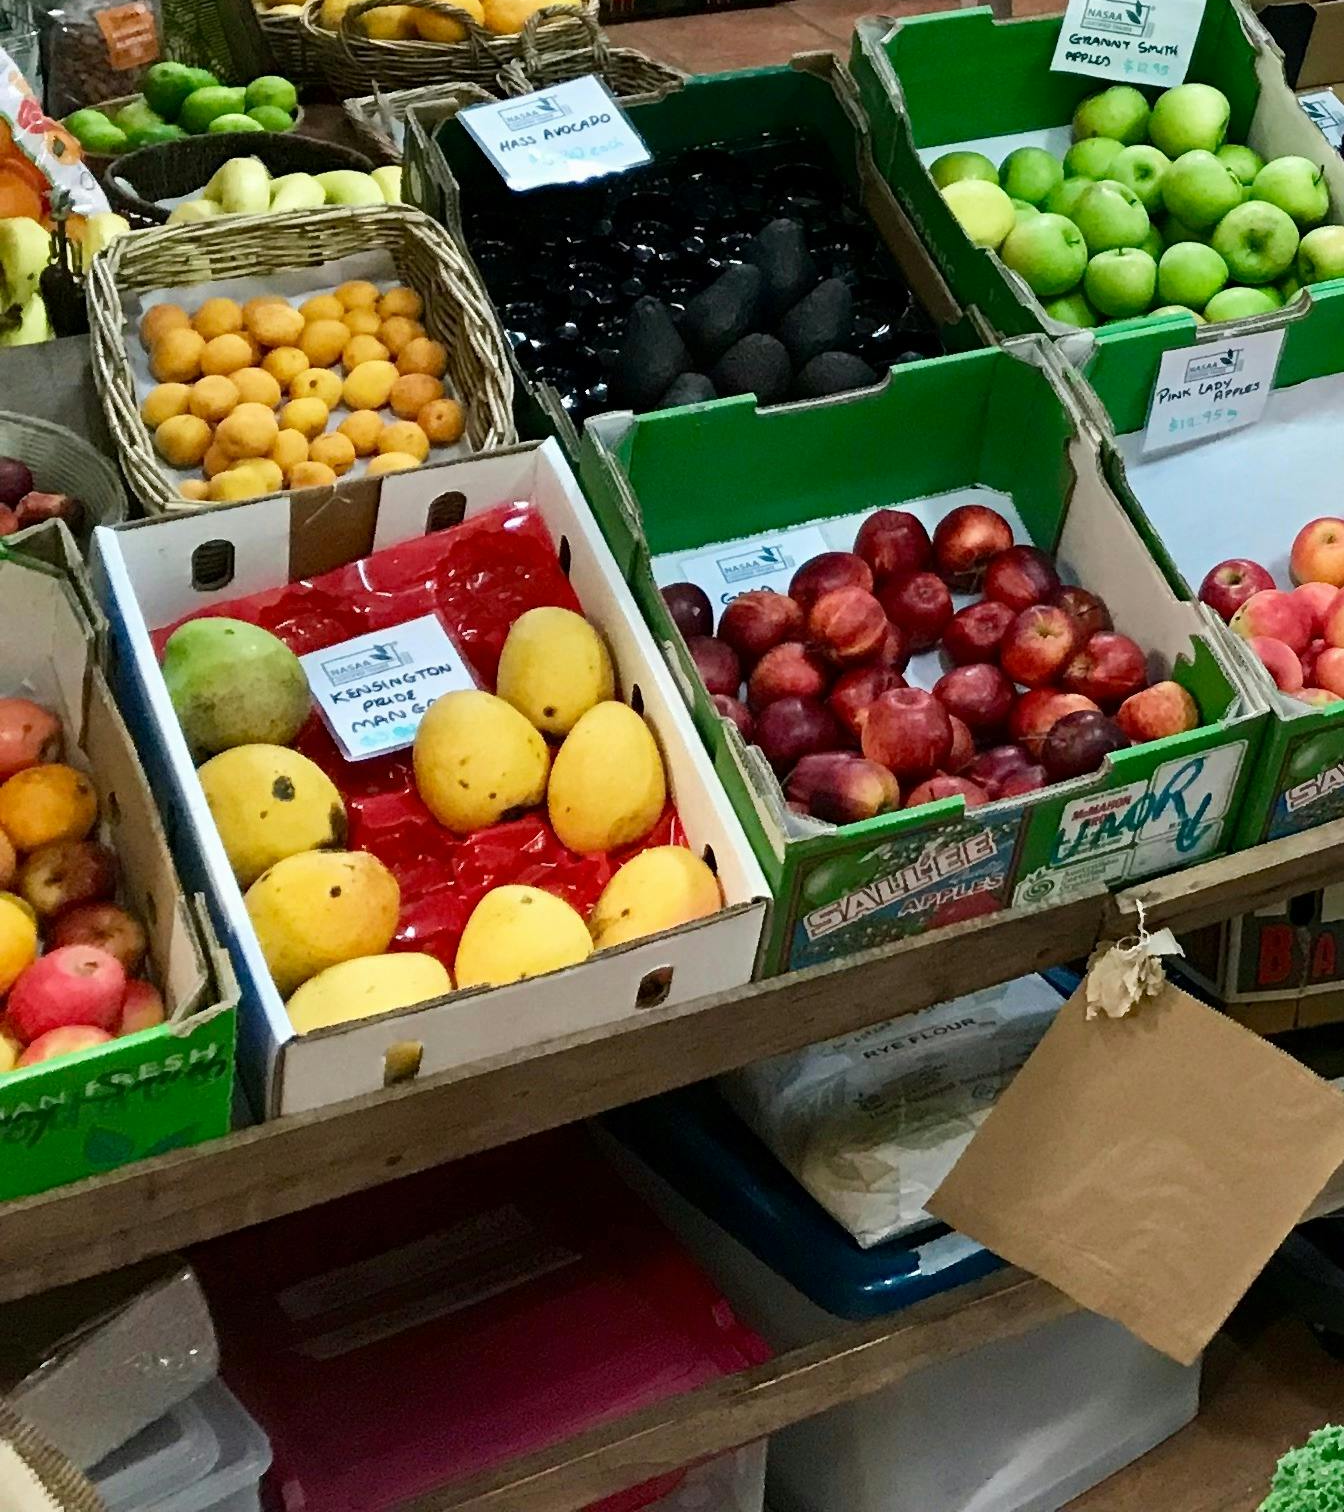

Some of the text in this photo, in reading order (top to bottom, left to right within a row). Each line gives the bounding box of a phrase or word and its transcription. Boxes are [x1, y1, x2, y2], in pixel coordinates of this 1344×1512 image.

[1087, 7, 1123, 22] NASAA
[1068, 33, 1179, 57] GRANNY SMITH
[500, 113, 611, 153] HASS AVOCADO
[1189, 361, 1218, 373] NASAA
[1156, 378, 1233, 405] PINK LADY
[1213, 381, 1261, 402] APPLES
[724, 559, 761, 573] NASAA
[330, 659, 371, 676] NASAA
[330, 663, 452, 705] KENSINGTON
[363, 689, 416, 713] PRIDE
[898, 872, 1006, 918] APPLES
[862, 1017, 978, 1060] RYE FLOUR
